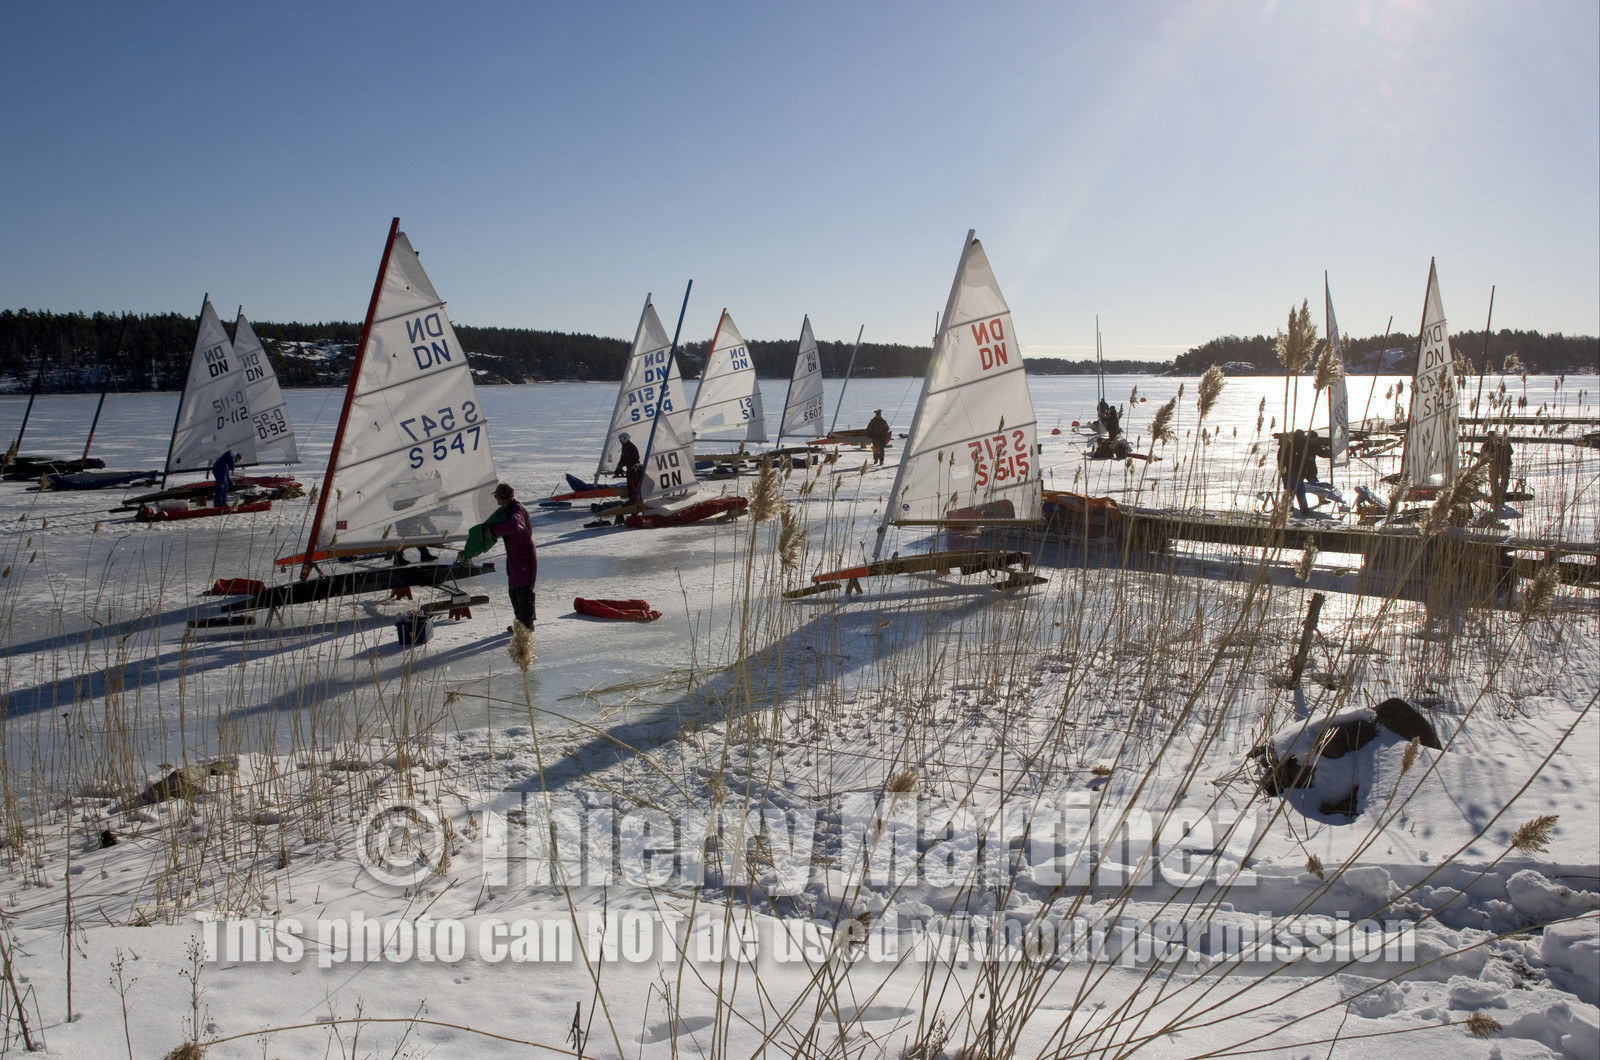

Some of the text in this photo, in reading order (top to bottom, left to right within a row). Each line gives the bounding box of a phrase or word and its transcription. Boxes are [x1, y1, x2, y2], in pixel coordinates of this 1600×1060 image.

[413, 339, 451, 370] DN
[732, 358, 748, 371] DN
[979, 342, 1008, 370] DN
[1426, 346, 1444, 370] DN
[209, 359, 229, 378] DN
[246, 366, 265, 382] DN
[645, 365, 667, 383] DN
[808, 360, 817, 372] DN
[217, 406, 248, 430] D-112
[643, 398, 674, 418] 54
[258, 420, 287, 439] D-92
[409, 426, 481, 469] S 547
[976, 453, 1030, 486] S 515
[660, 470, 683, 490] DN
